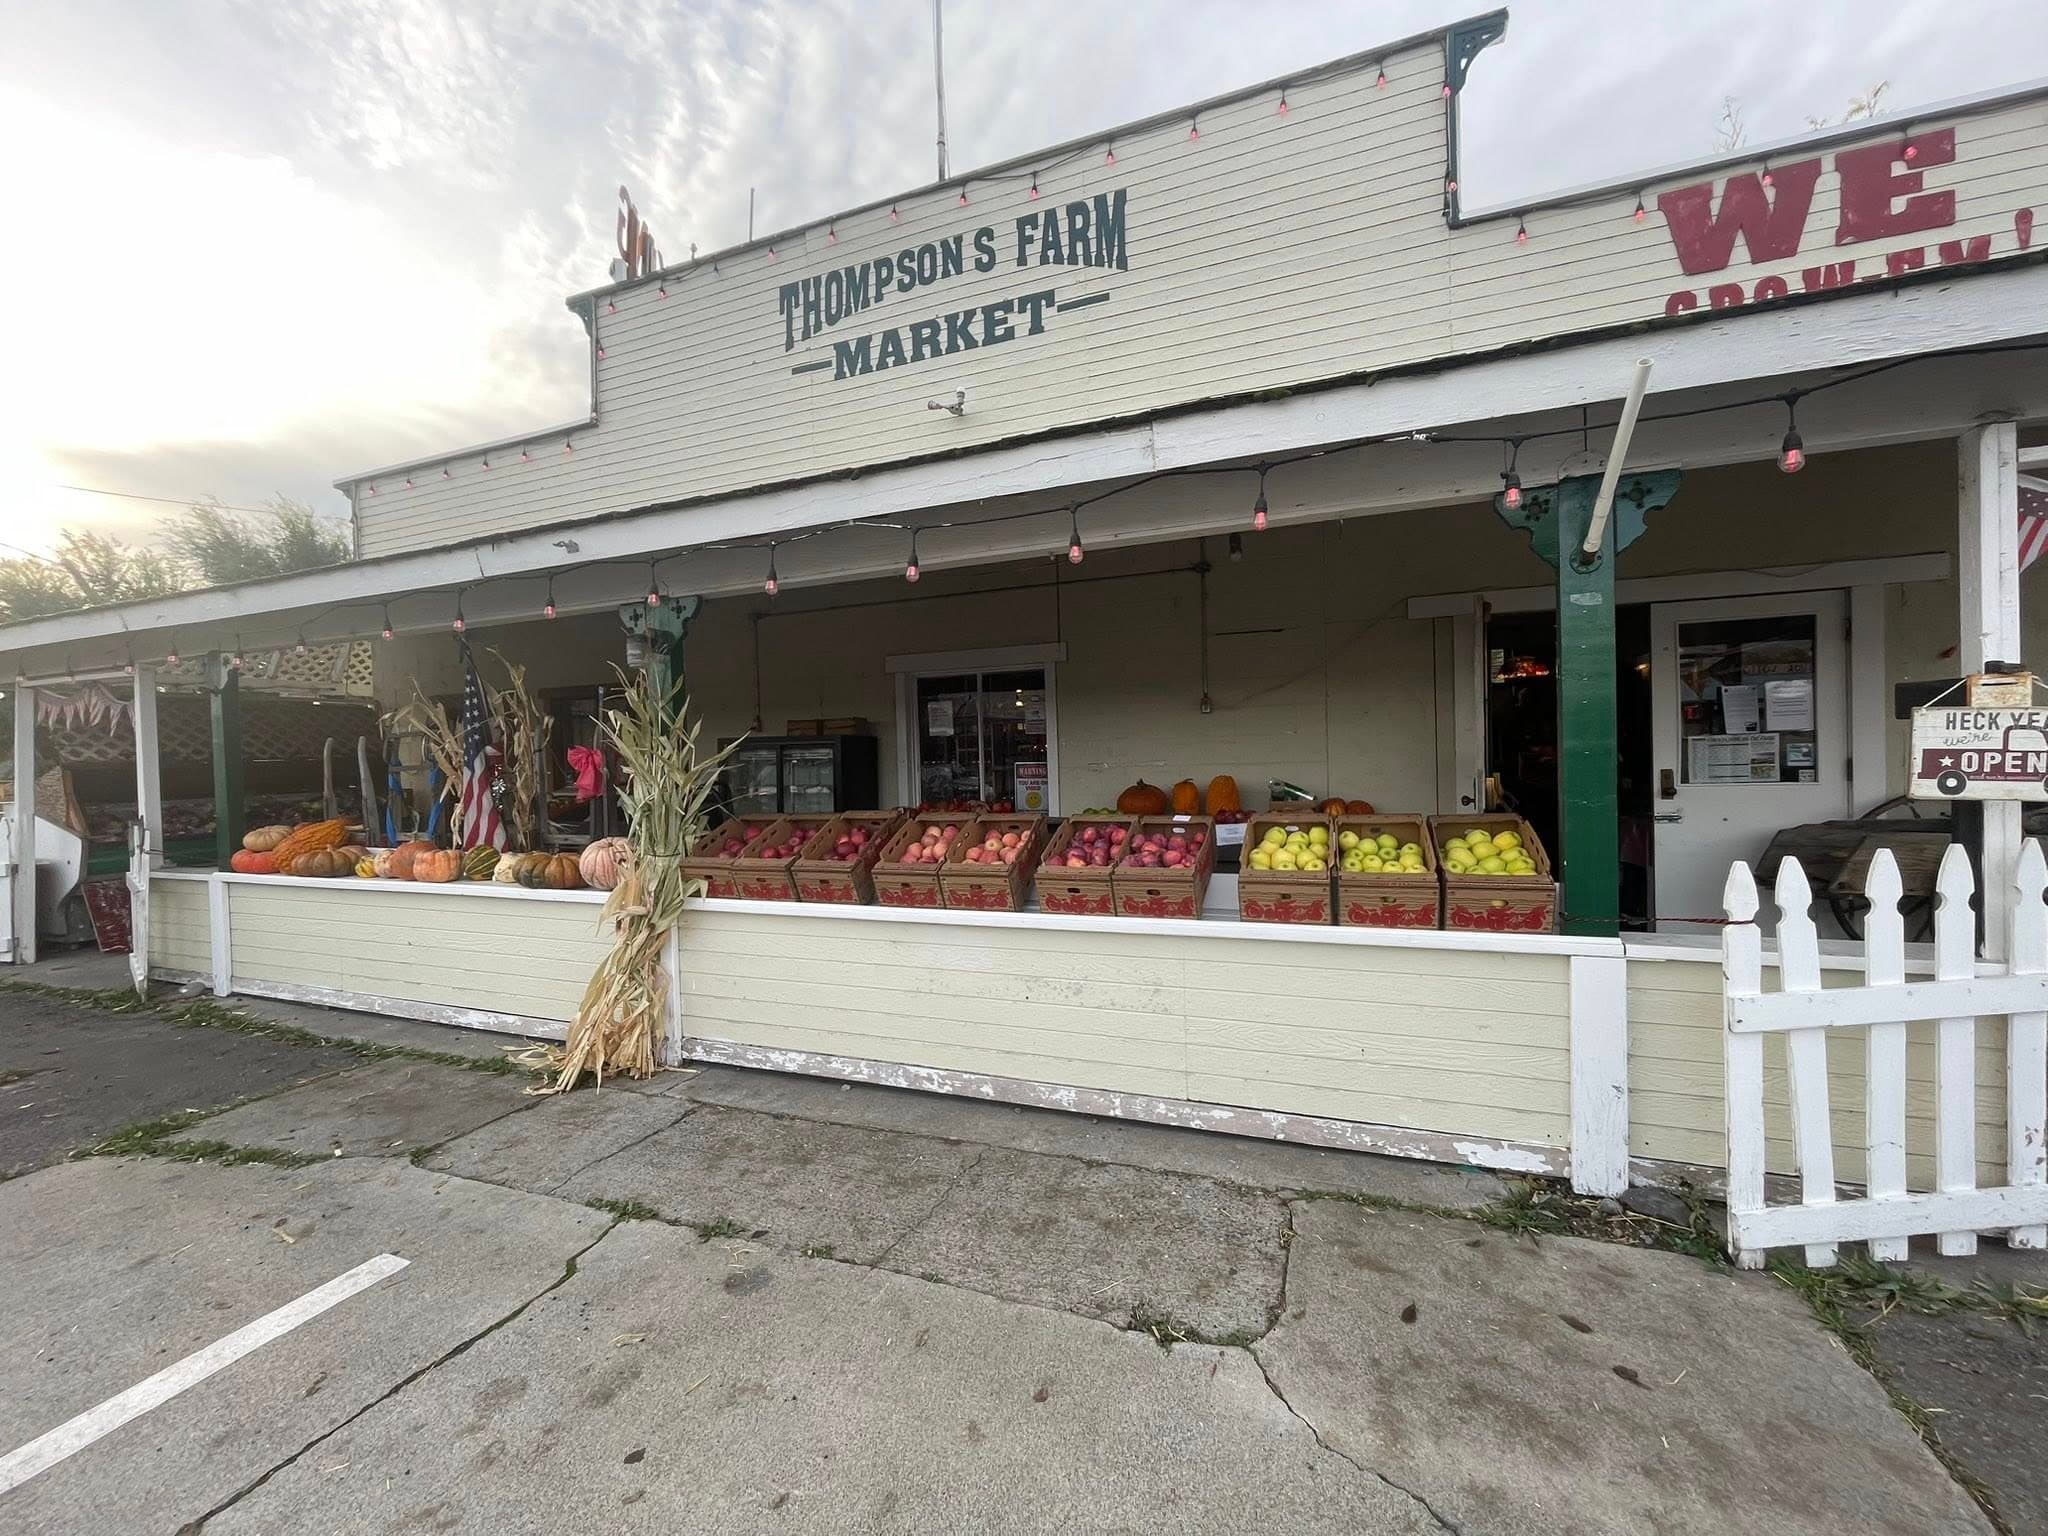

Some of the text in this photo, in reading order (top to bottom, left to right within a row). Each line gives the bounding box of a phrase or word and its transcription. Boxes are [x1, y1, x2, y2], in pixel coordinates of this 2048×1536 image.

[1016, 189, 1128, 271] FARM
[1658, 128, 1956, 276] WE
[833, 289, 1056, 380] MARKET
[1945, 711, 2048, 732] HECK YE
[1960, 751, 2047, 774] OPEN
